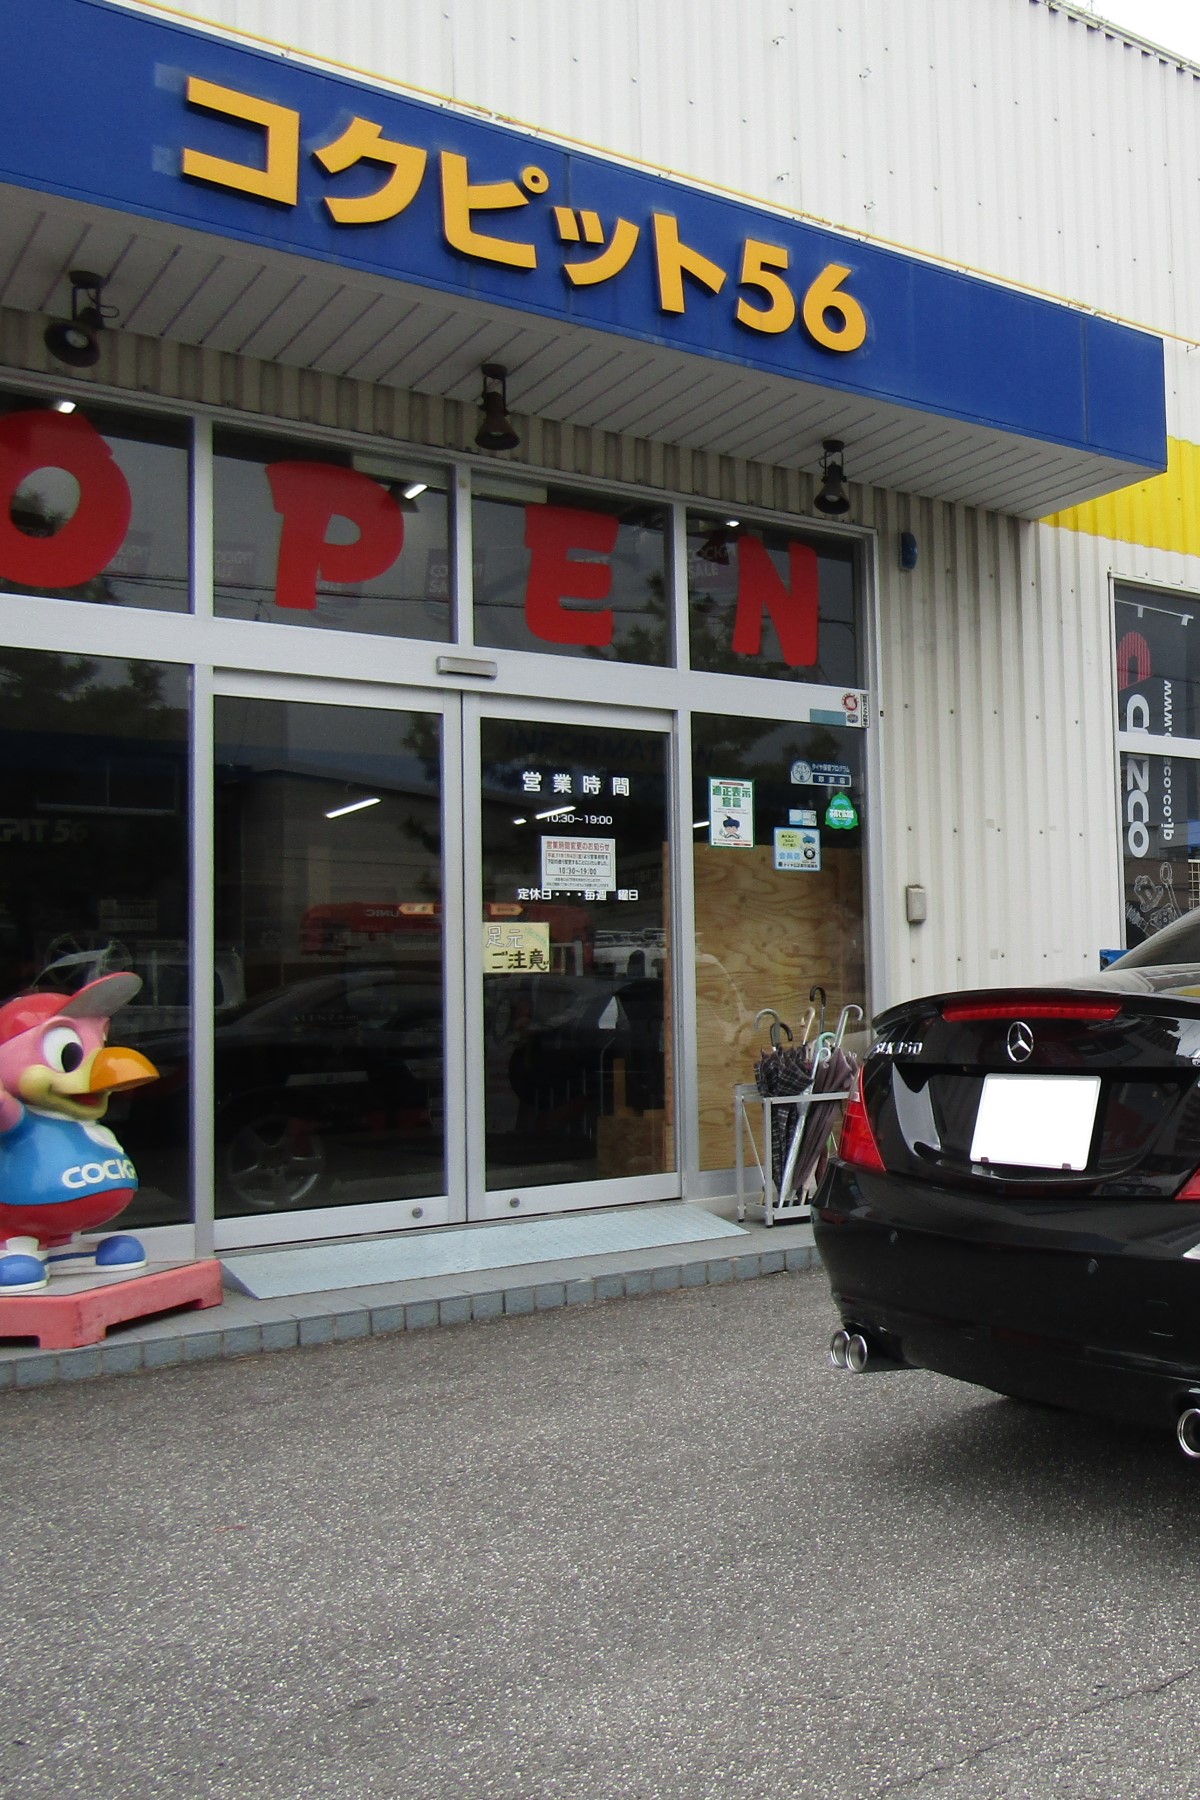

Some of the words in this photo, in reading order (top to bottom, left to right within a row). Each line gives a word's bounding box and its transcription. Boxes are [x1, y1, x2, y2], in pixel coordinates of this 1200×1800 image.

[182, 75, 867, 352] コクピット56
[0, 409, 820, 666] OPEN
[522, 771, 630, 797] 営業時間
